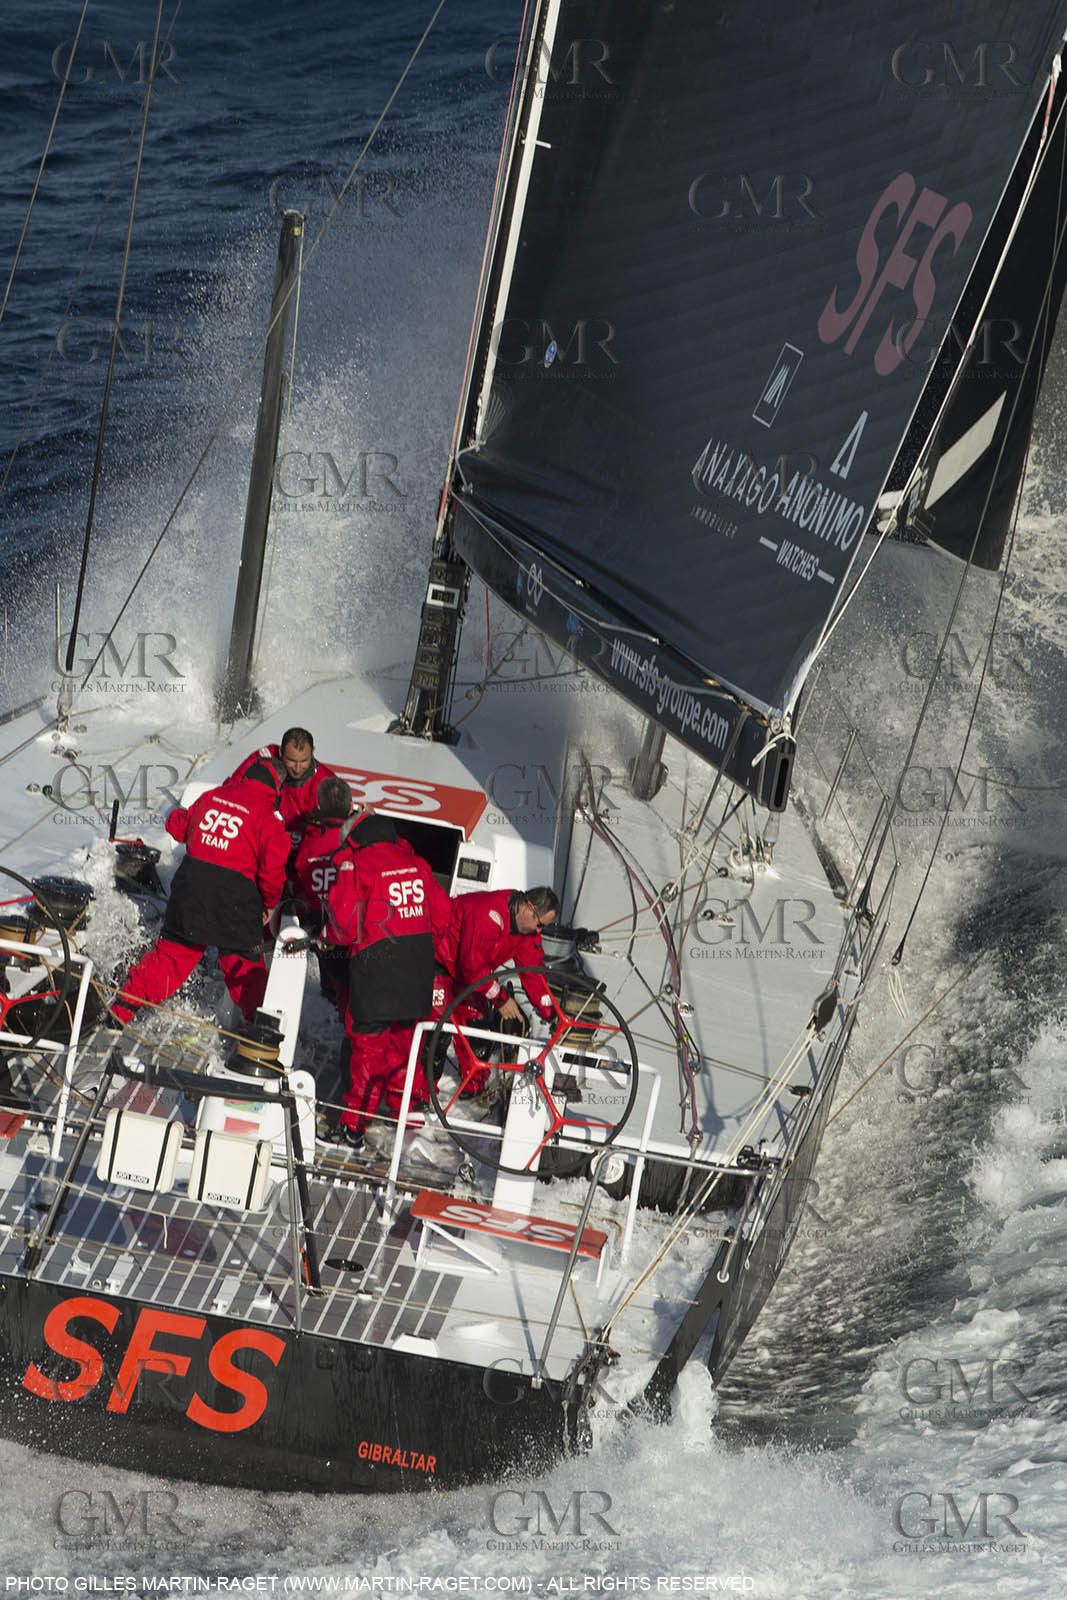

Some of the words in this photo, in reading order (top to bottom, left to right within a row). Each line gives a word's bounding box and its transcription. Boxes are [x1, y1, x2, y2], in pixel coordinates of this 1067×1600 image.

[817, 172, 973, 376] SFS
[691, 437, 779, 514] ANAXAGO
[774, 471, 865, 552] ANONIMO
[775, 539, 820, 582] WATCHES
[610, 637, 729, 750] www.sfs-groupe.com
[199, 808, 243, 839] SFS
[200, 832, 229, 851] TEAM
[311, 867, 337, 892] SF
[388, 878, 424, 906] SFS
[397, 904, 424, 919] TEAM
[432, 988, 445, 1001] FS
[21, 1297, 286, 1433] SFS
[357, 1440, 437, 1474] GIBRALTAR
